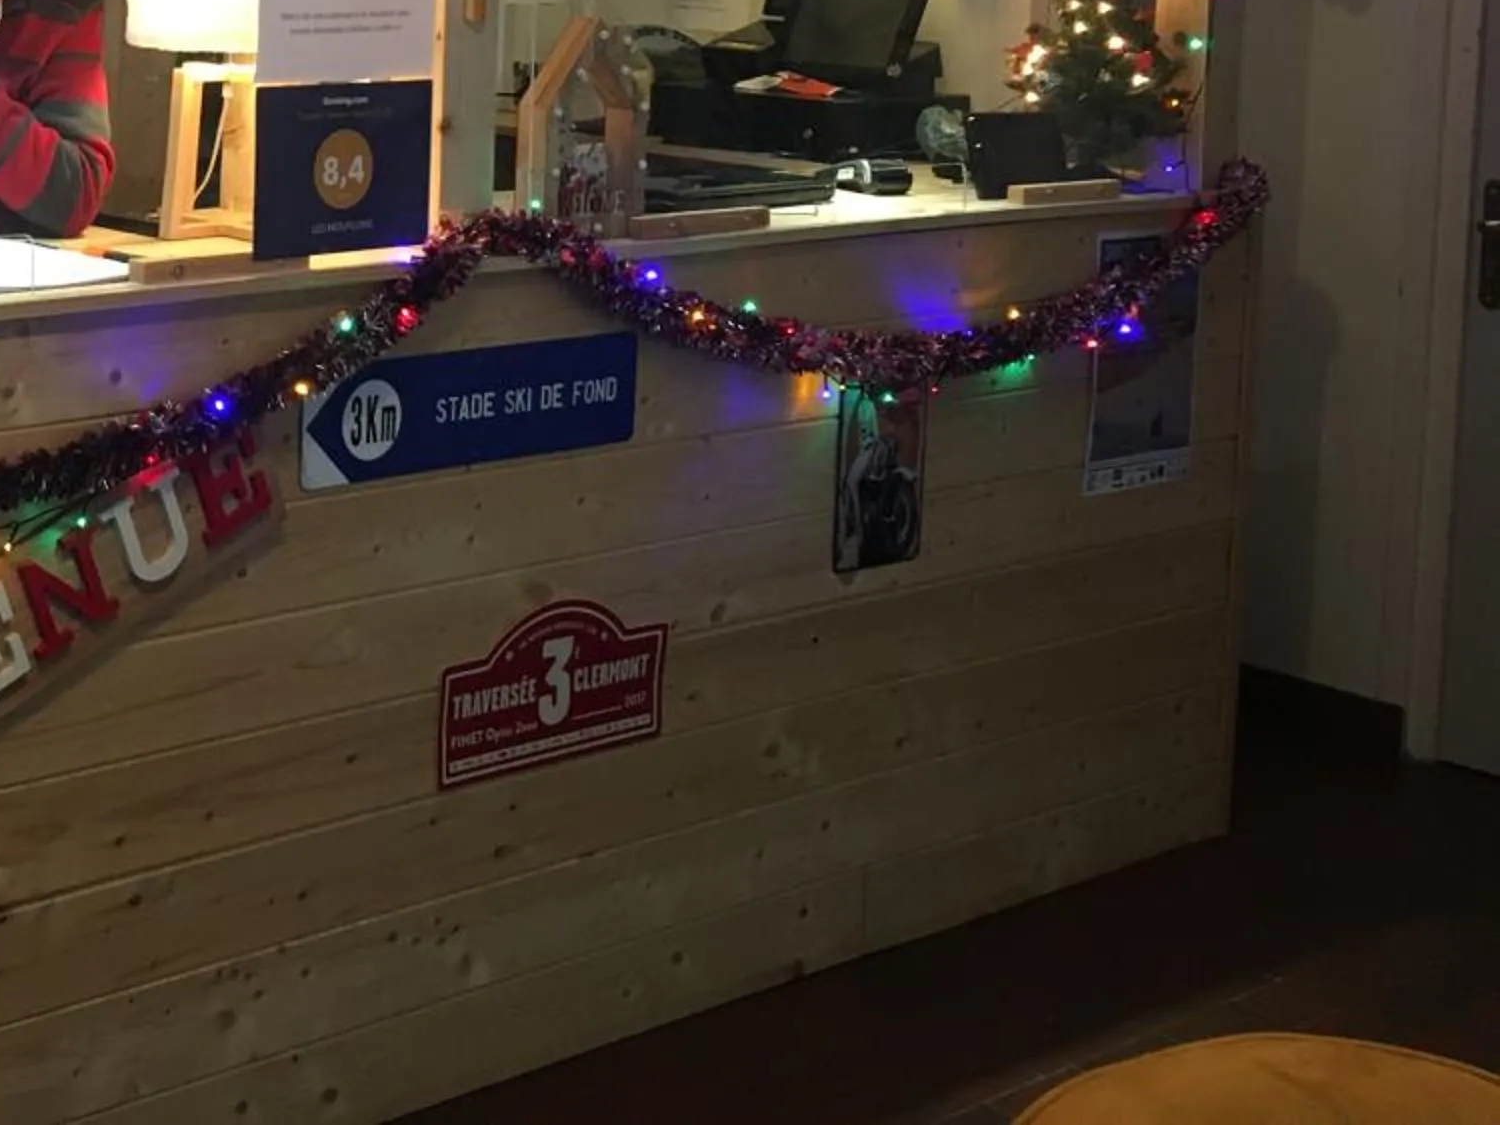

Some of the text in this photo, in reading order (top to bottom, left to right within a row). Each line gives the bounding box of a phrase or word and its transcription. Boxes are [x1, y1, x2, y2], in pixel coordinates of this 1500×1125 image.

[322, 154, 365, 189] 8,4
[435, 376, 618, 424] STADE SKI DE FOND
[452, 676, 538, 721] TRAVERSÉE
[574, 653, 650, 692] CLERMONT
